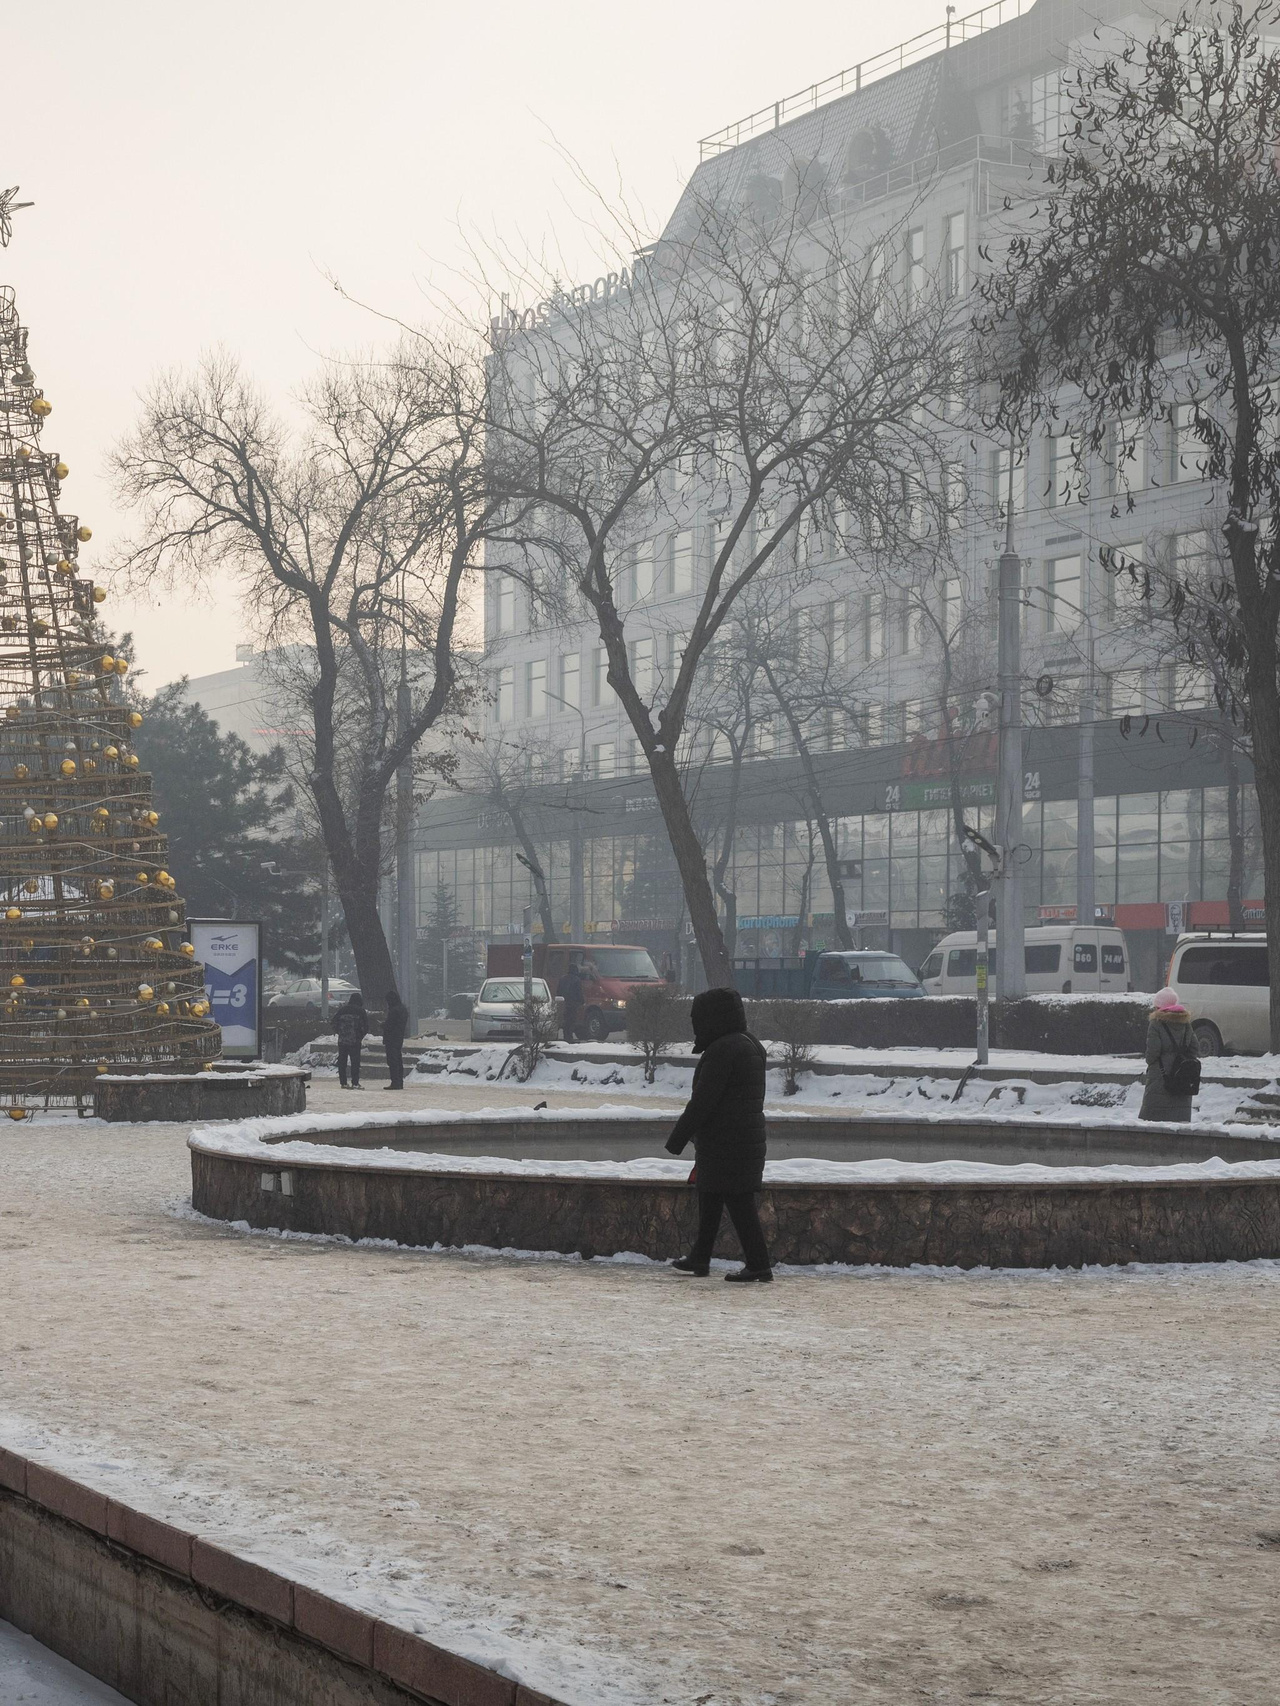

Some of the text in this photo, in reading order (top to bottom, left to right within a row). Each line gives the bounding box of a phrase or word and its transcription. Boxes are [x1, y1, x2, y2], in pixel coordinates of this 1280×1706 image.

[1024, 772, 1041, 790] 24
[885, 785, 900, 803] 24
[924, 783, 993, 802] ГИПЕРАРКЕТ
[210, 943, 239, 951] ERKE
